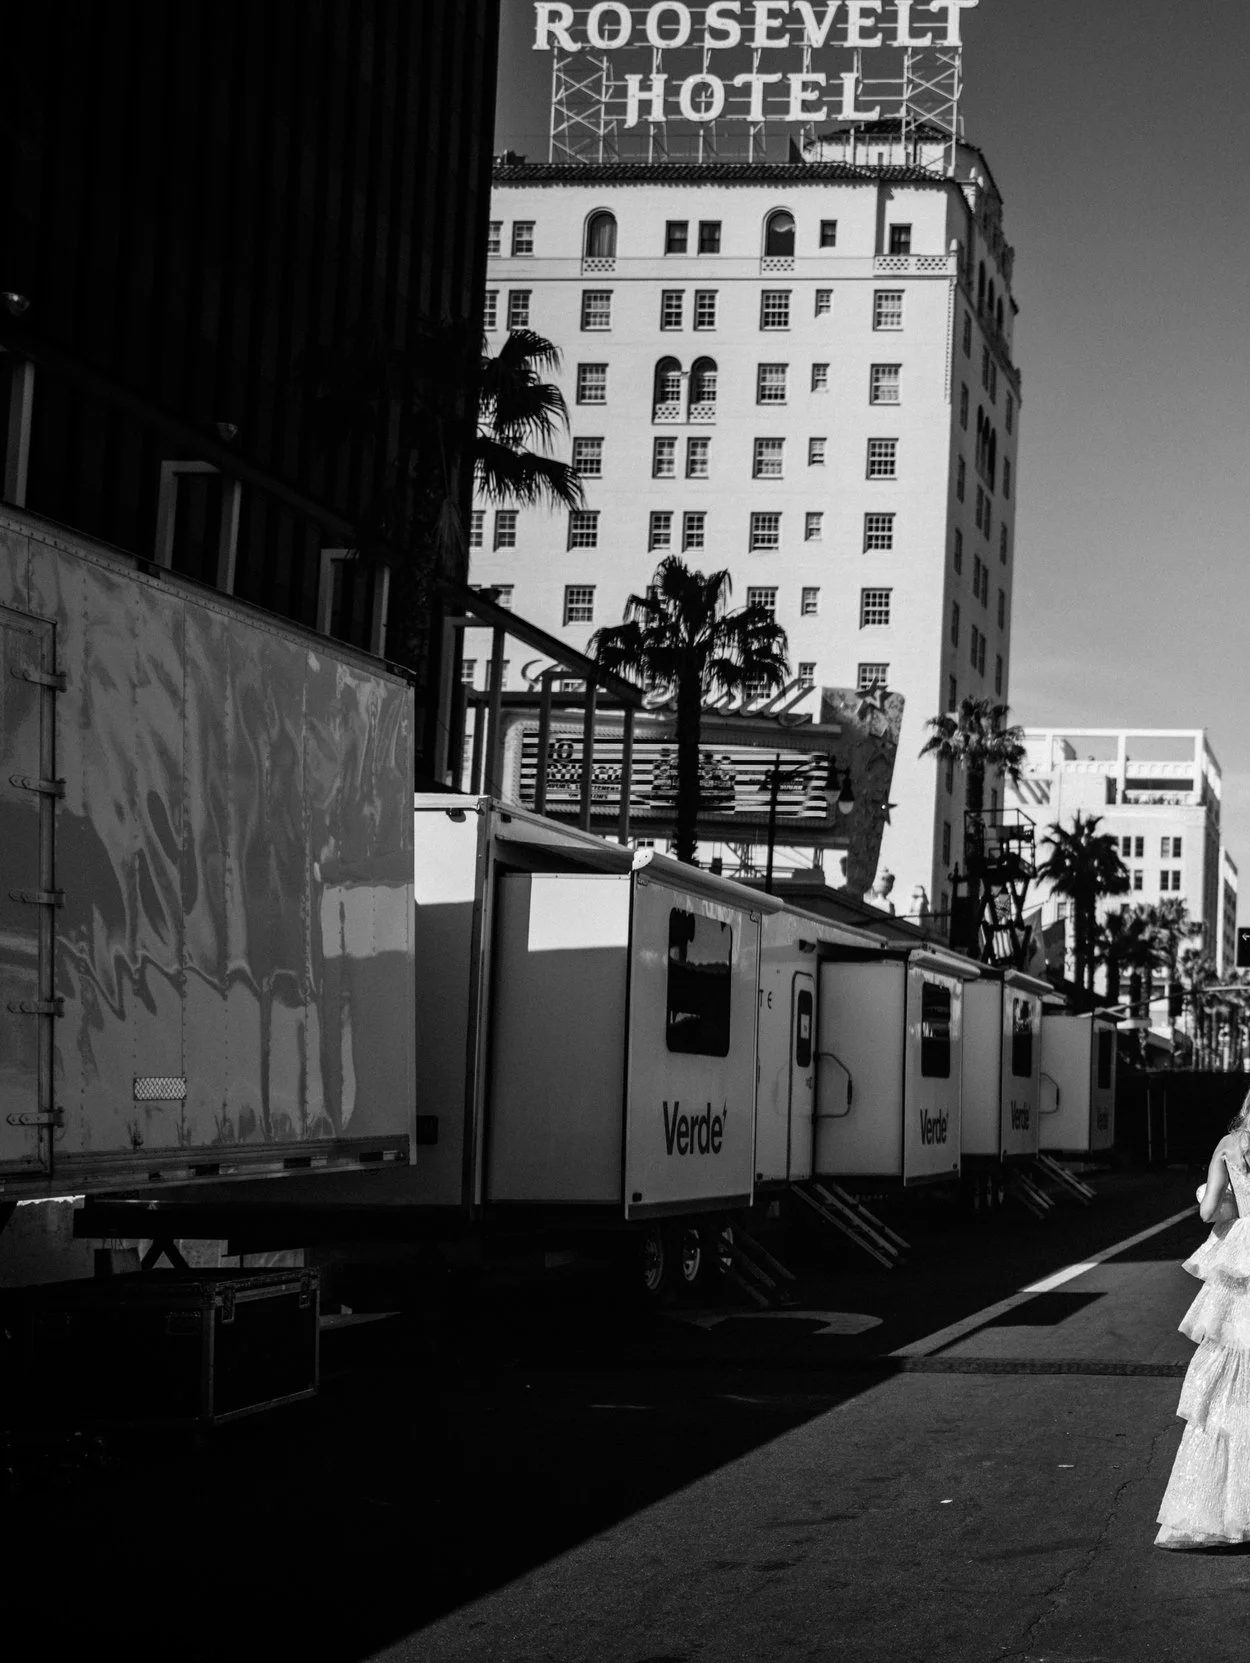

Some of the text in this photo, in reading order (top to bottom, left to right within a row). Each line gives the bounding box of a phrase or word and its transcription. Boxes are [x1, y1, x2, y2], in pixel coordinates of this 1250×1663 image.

[532, 0, 980, 53] ROOSEVELT
[624, 73, 881, 128] HOTEL
[662, 1100, 723, 1156] Verde
[919, 1108, 948, 1146] Verde
